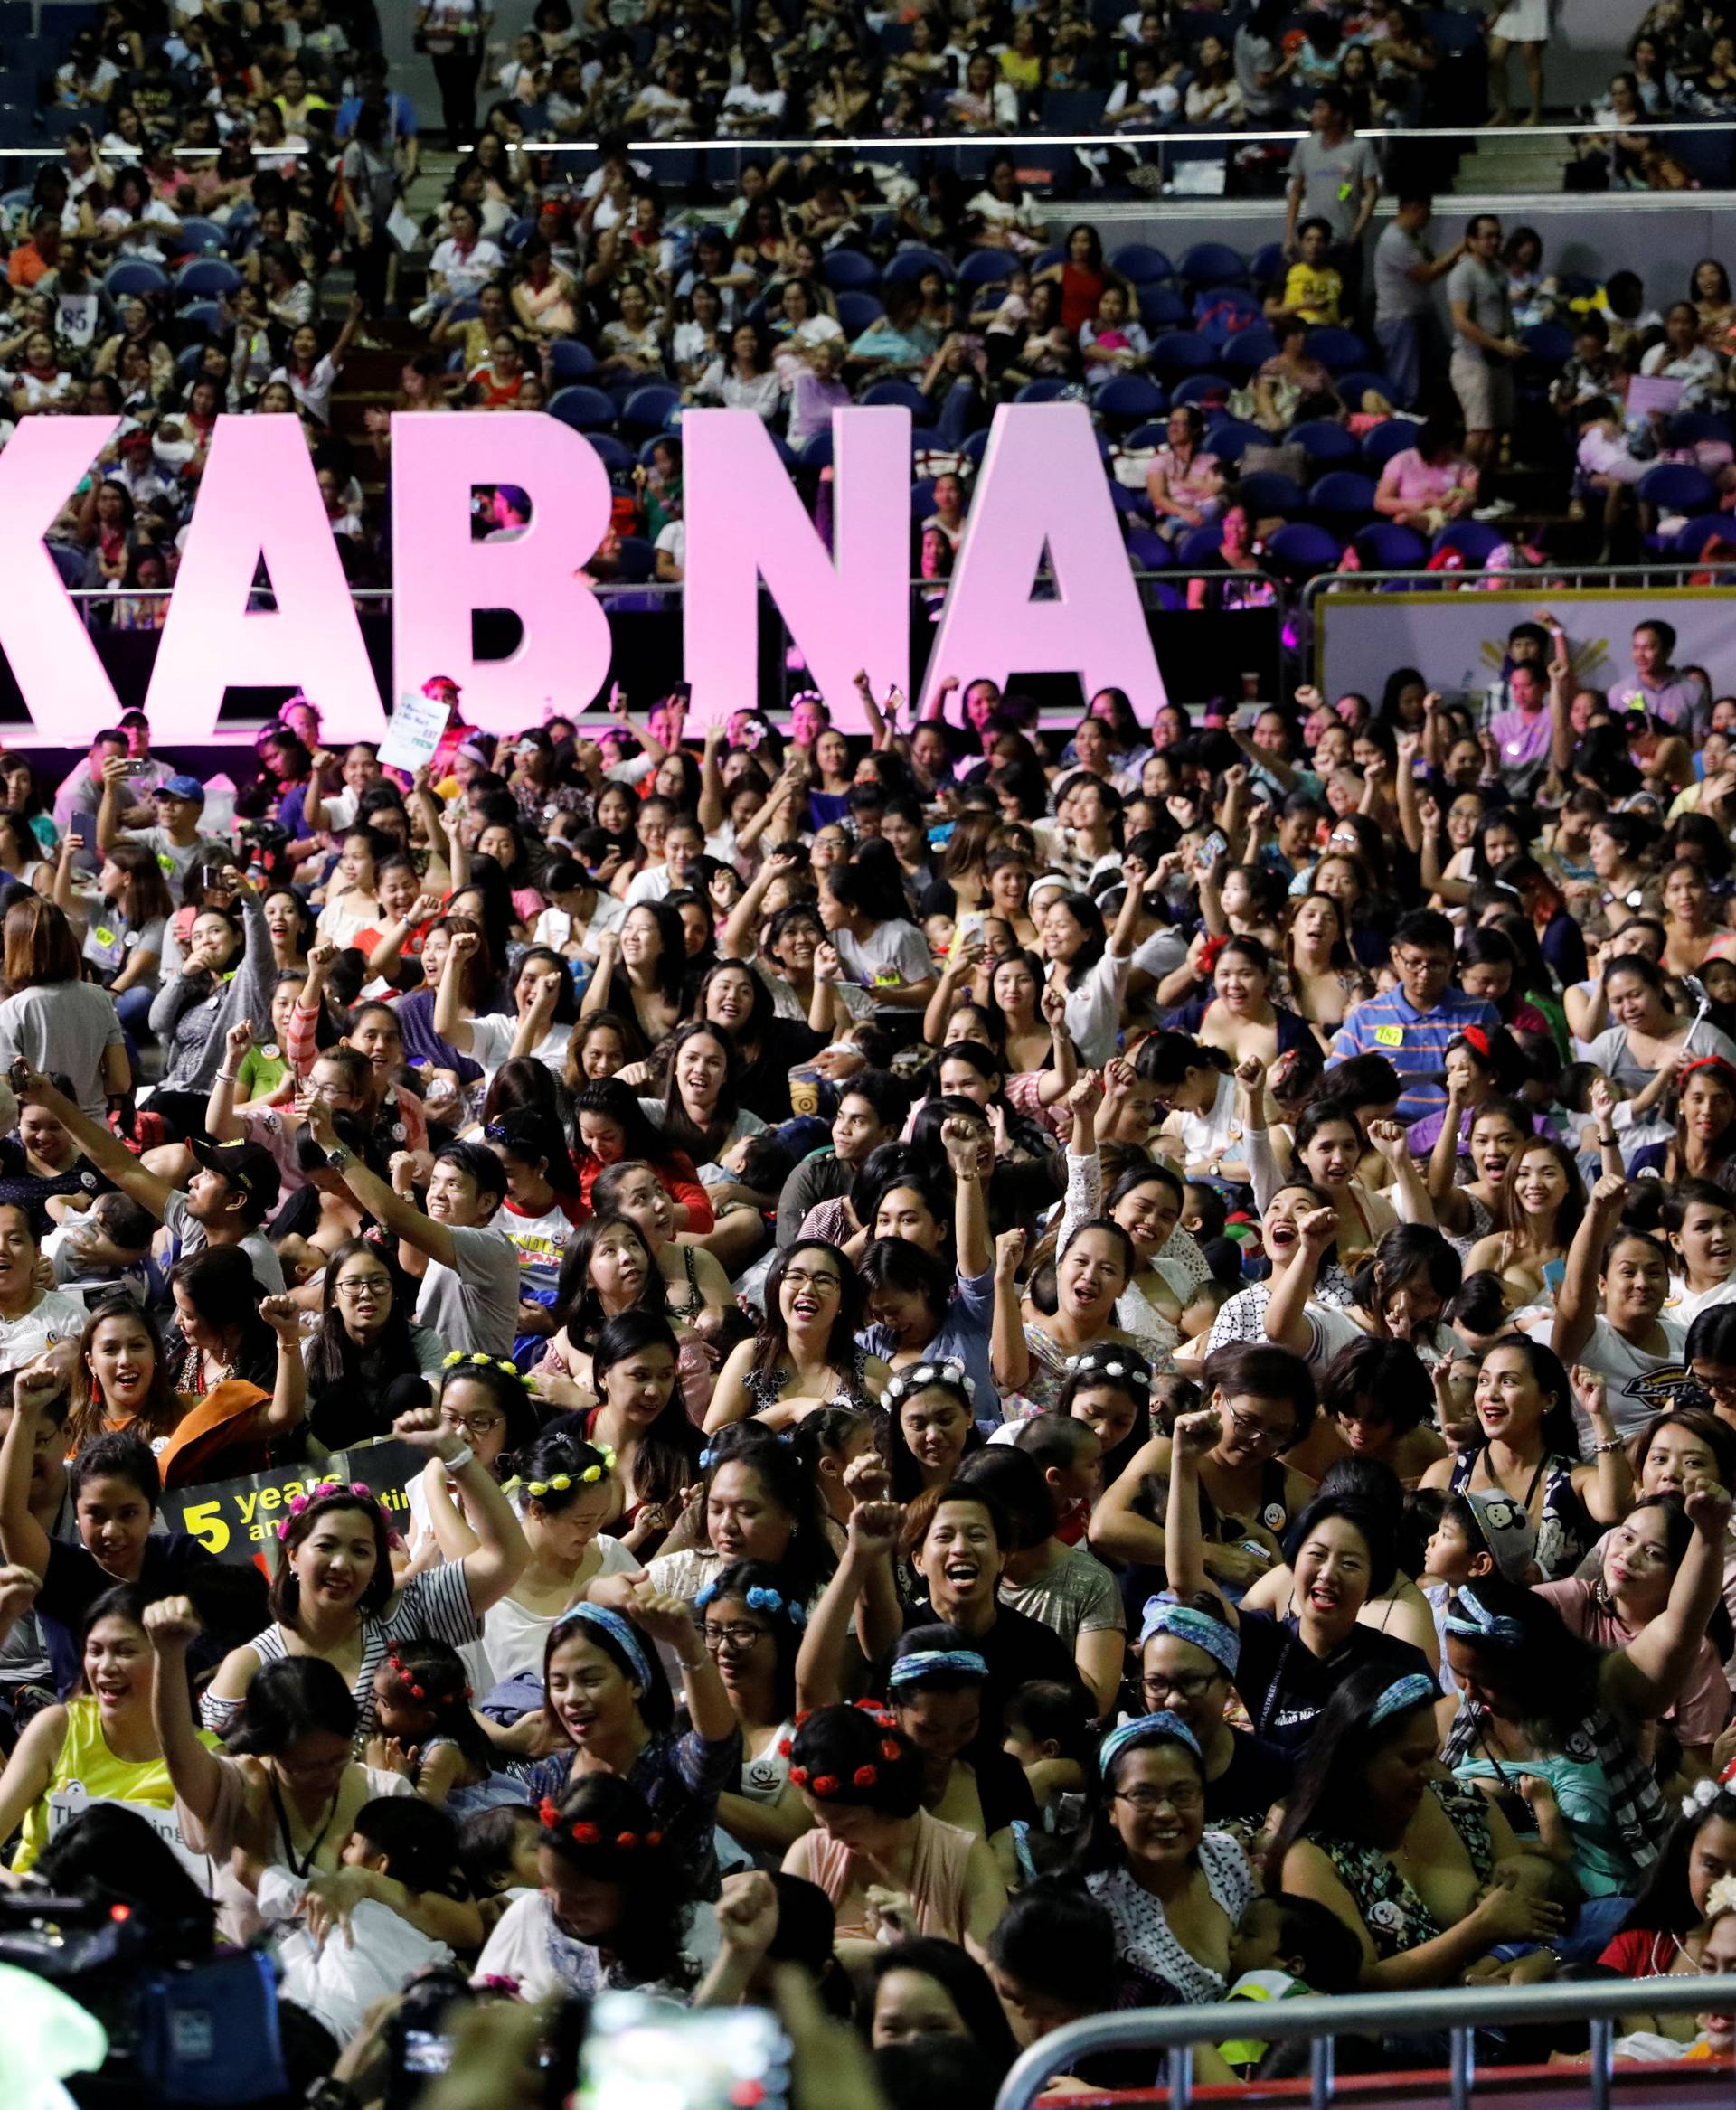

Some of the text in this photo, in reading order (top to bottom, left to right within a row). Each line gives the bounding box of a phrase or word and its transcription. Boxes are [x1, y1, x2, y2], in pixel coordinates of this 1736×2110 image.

[61, 309, 87, 331] 85
[683, 402, 1168, 735] NA
[183, 1500, 230, 1554] 5
[249, 1519, 280, 1541] an
